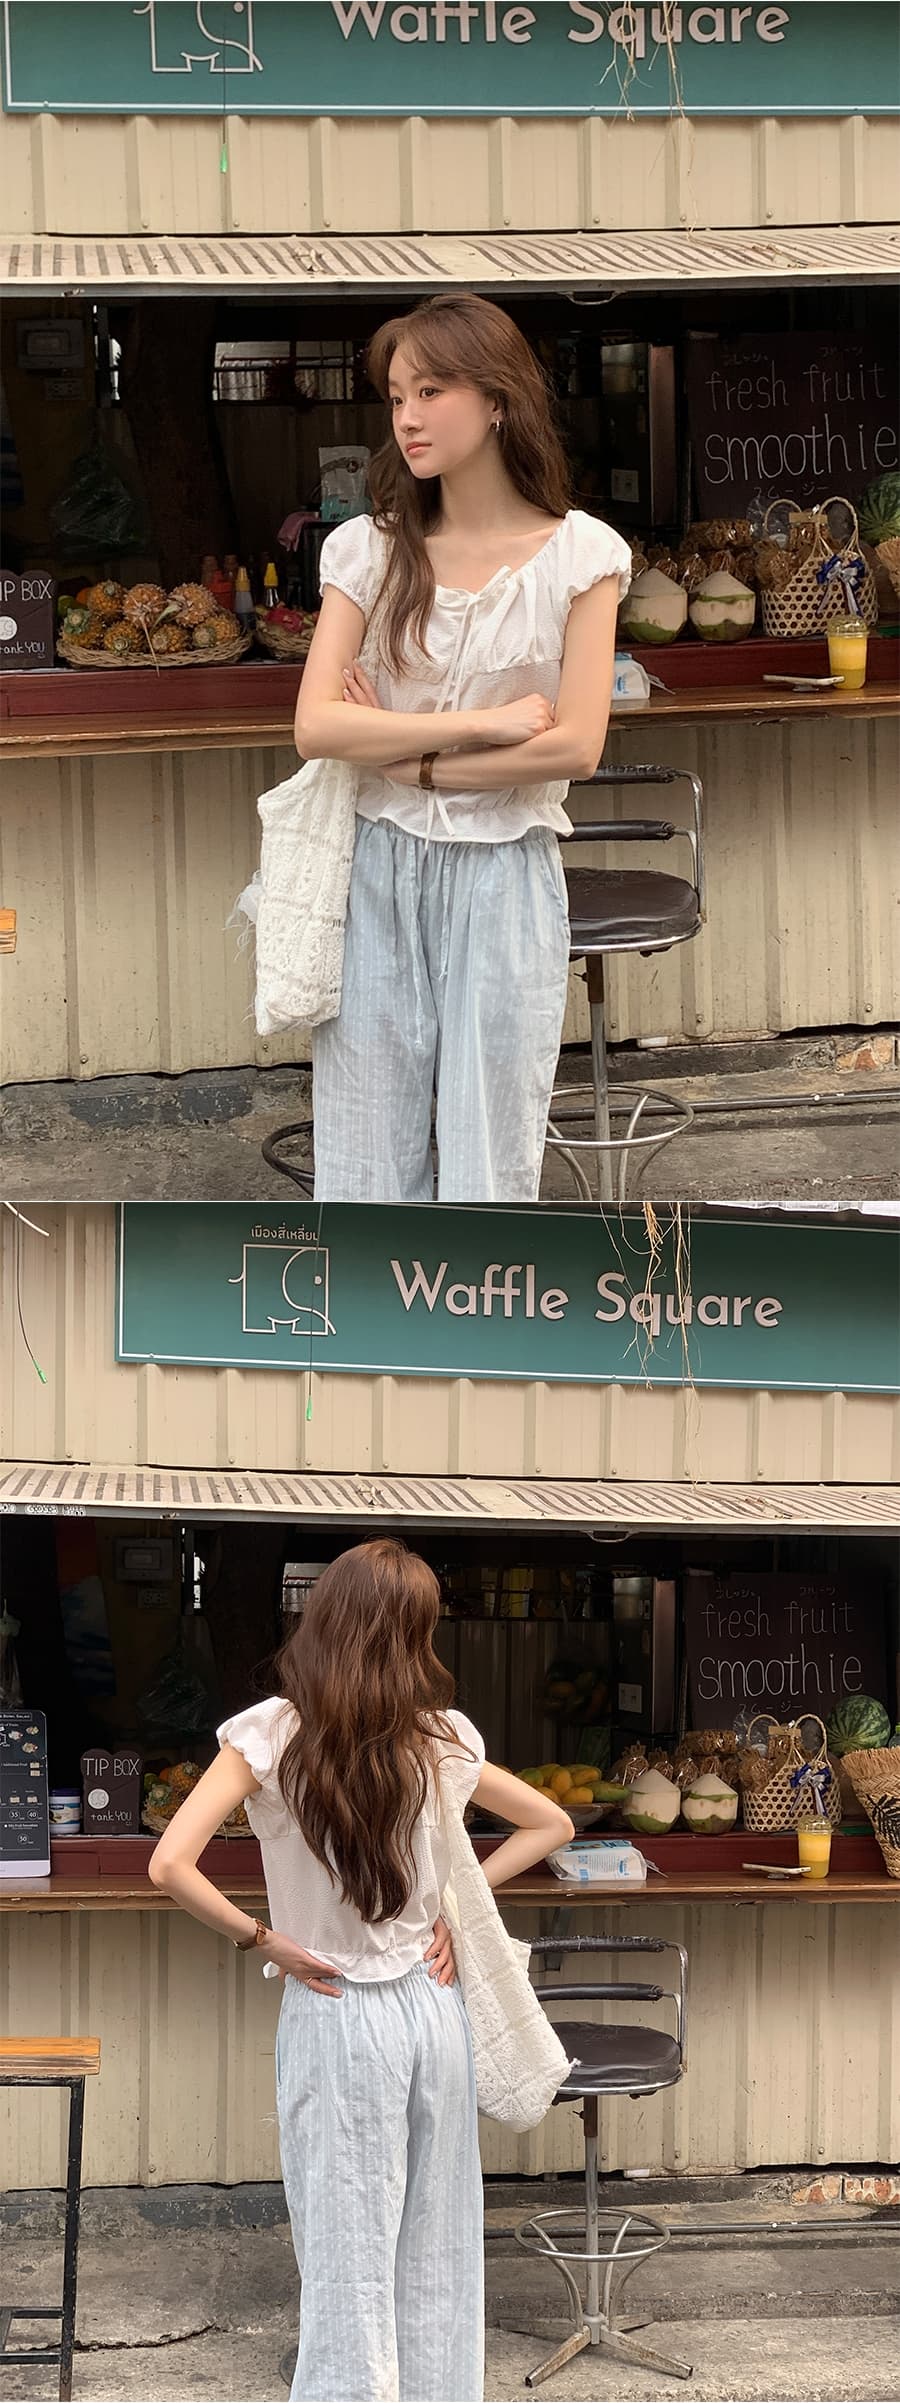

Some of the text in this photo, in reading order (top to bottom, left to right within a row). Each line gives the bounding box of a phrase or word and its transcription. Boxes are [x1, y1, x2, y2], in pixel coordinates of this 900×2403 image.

[332, 0, 789, 58] Waffle Square
[705, 360, 887, 412] fresh fruit
[704, 412, 898, 484] smoothie
[21, 579, 52, 601] BOX
[391, 1260, 783, 1337] Waffle Square
[700, 1596, 856, 1638] fresh fruit
[697, 1643, 863, 1700] smoothie
[83, 1758, 140, 1777] TIP BOX
